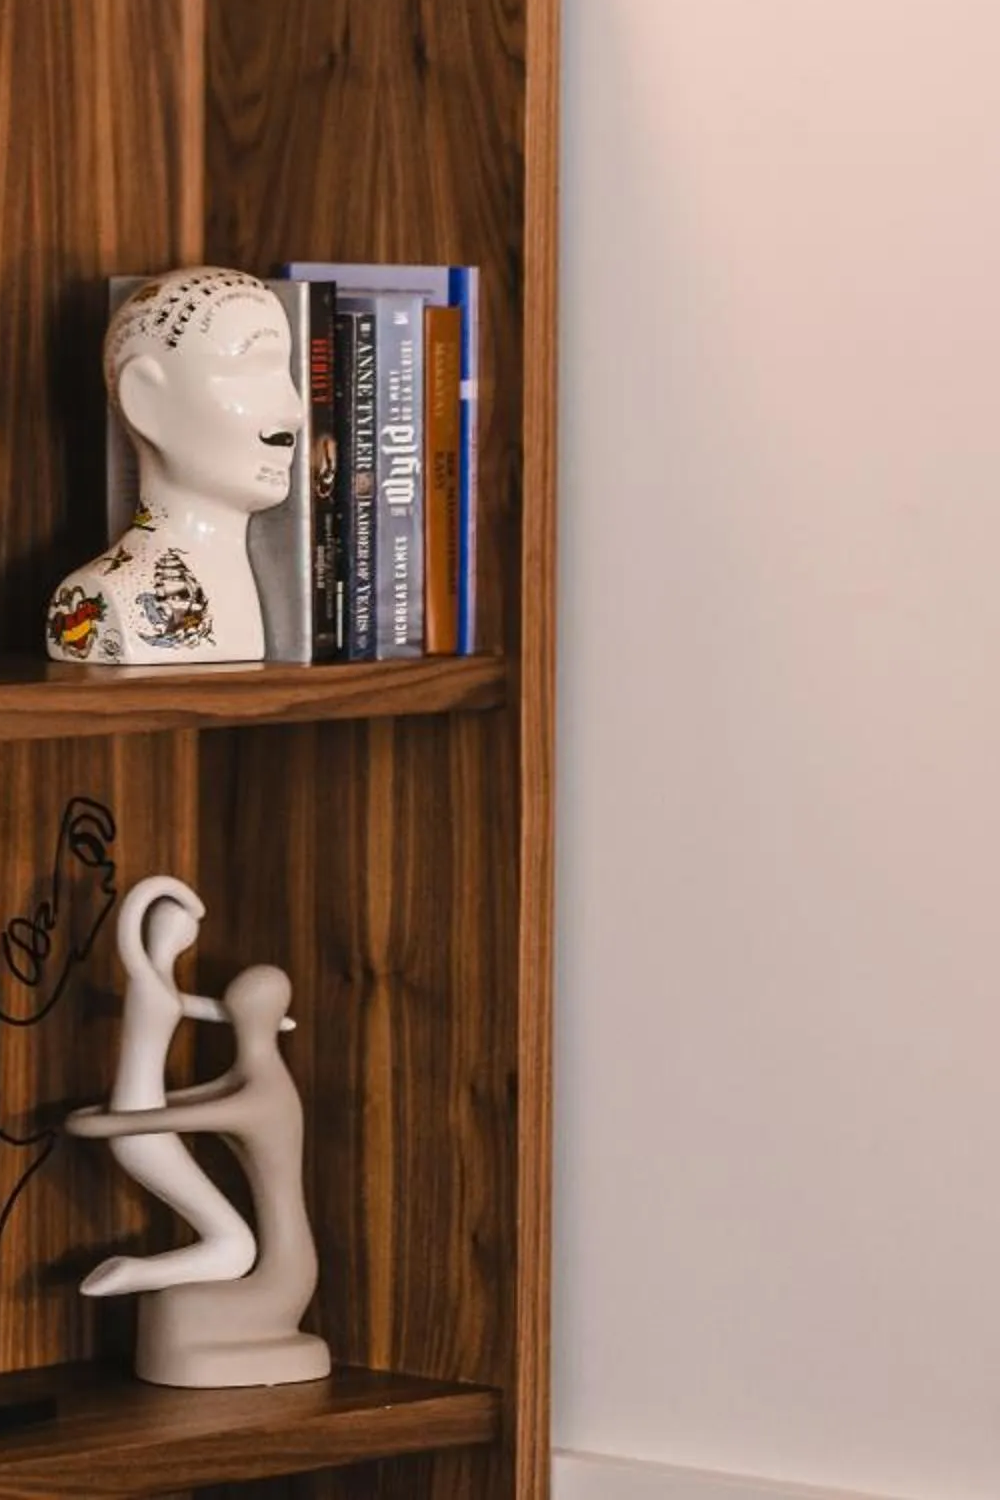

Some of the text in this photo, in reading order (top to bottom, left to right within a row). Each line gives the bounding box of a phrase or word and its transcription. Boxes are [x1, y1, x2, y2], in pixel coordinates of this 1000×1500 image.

[356, 341, 373, 396] ANNE
[356, 400, 373, 470] TYLER
[394, 583, 408, 645] NICHOLAS
